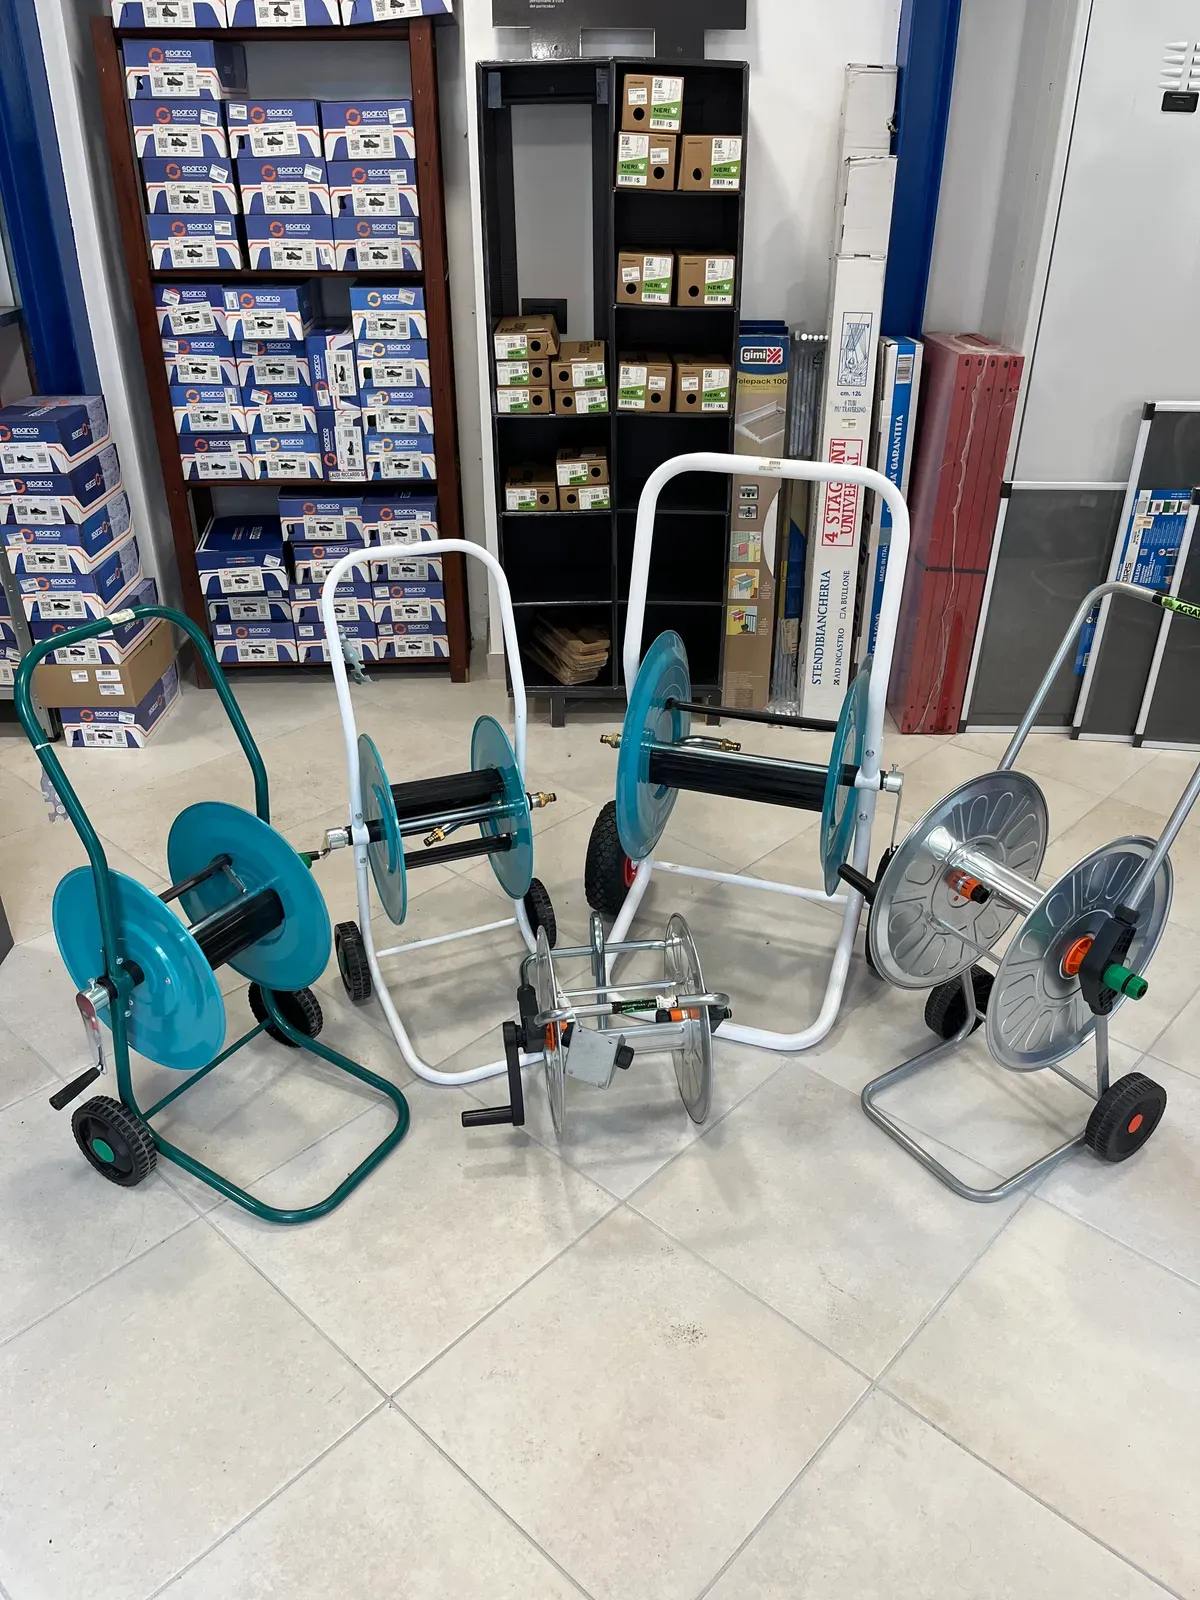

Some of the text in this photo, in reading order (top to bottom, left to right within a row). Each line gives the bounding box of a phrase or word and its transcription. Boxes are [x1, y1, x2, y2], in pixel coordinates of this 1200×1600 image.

[165, 49, 191, 58] sparco
[172, 109, 198, 118] sparco
[266, 108, 293, 117] sparco
[362, 109, 388, 118] sparco
[182, 165, 208, 174] sparco
[277, 166, 303, 175] sparco
[368, 169, 391, 177] sparc
[187, 223, 213, 231] sparco
[285, 223, 310, 231] sparco
[372, 223, 397, 231] sparco
[182, 290, 207, 298] sparco
[256, 295, 281, 303] sparco
[190, 342, 215, 350] sparco
[386, 344, 411, 352] sparco
[744, 350, 766, 361] gimi
[201, 390, 225, 398] sparco
[273, 390, 298, 398] sparco
[12, 426, 39, 436] sparco
[281, 438, 304, 446] sparco
[395, 438, 418, 446] sparco
[891, 415, 904, 470] GARANTITA
[27, 480, 53, 489] sparco
[825, 442, 846, 543] 4 STAGNI
[317, 503, 340, 511] sparco
[394, 509, 417, 517] sparco
[35, 529, 61, 538] sparco
[51, 578, 77, 587] sparco
[404, 586, 426, 594] sparco
[841, 570, 851, 605] BULLONE
[408, 624, 429, 632] sparco
[812, 570, 831, 685] STENDIBIANCHERIA
[249, 628, 271, 636] sparco
[835, 628, 845, 667] INCASTRO
[834, 669, 841, 680] AD
